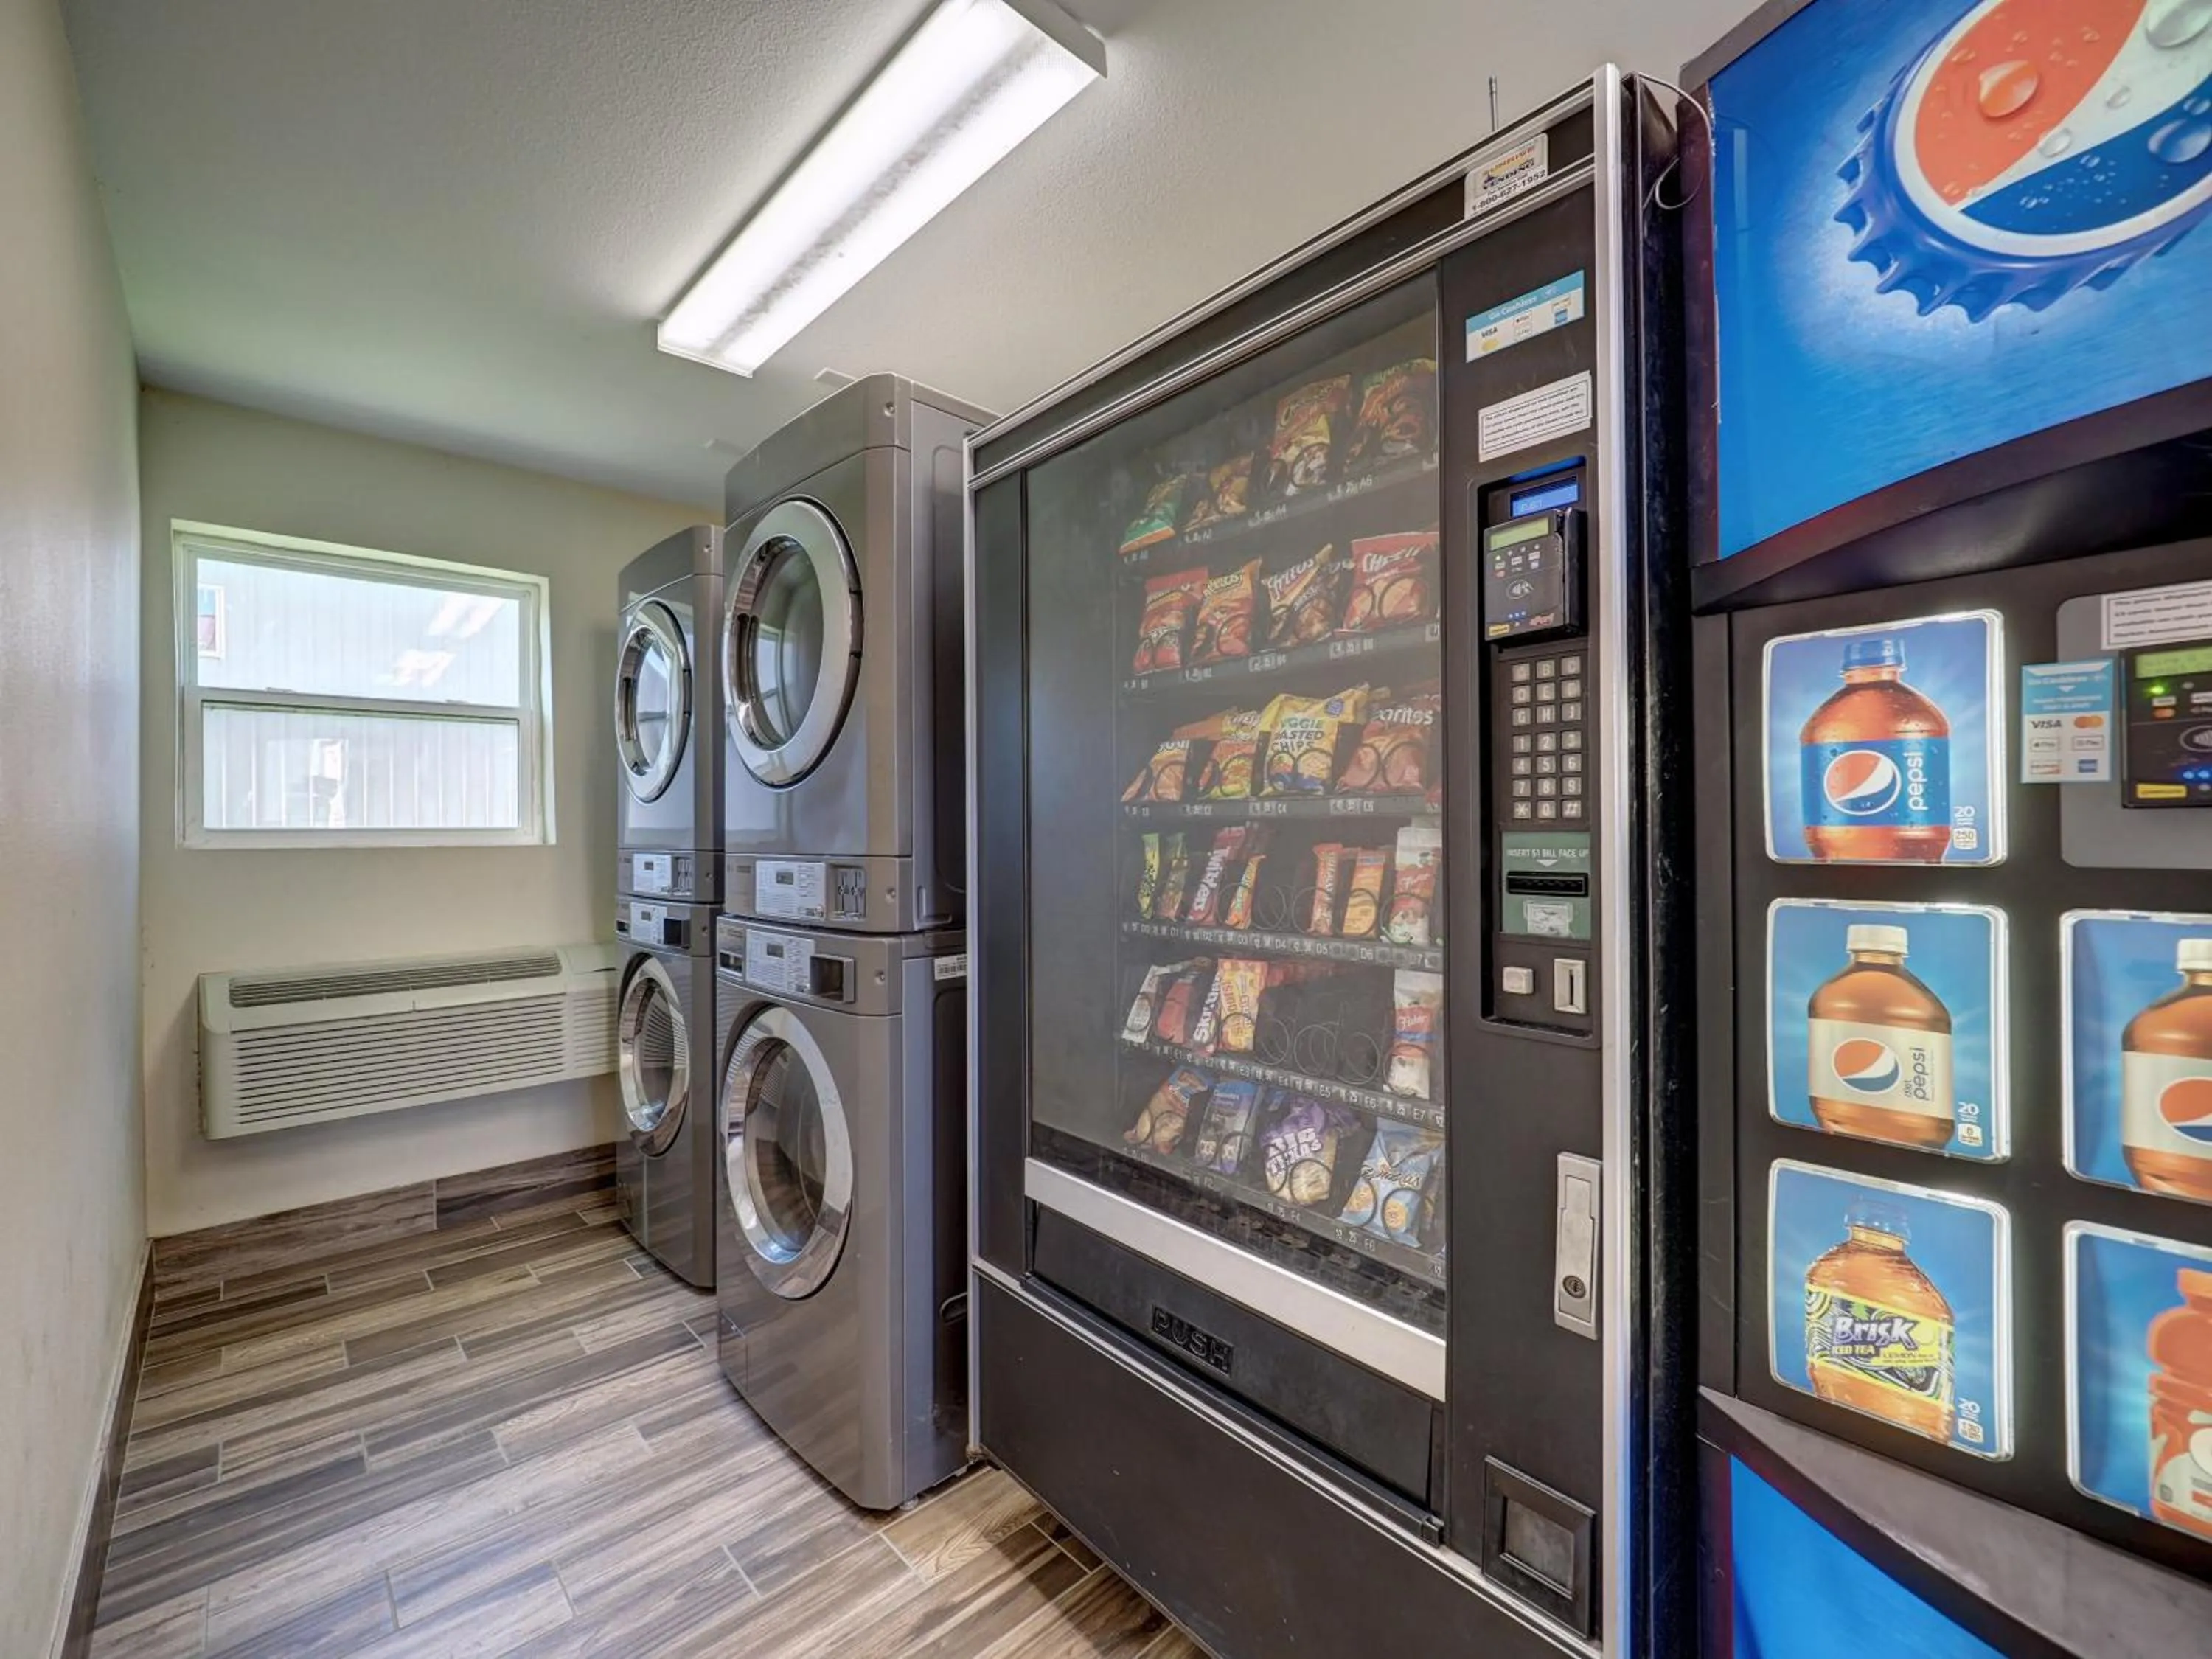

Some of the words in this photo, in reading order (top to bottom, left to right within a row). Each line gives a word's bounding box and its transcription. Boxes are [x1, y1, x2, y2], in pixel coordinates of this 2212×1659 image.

[2031, 719, 2062, 730] VISA
[1274, 729, 1325, 740] ASTED
[1519, 737, 1526, 749] 1
[1543, 735, 1551, 748] 2
[1517, 759, 1526, 771] 4
[1543, 757, 1551, 771] 5
[1568, 756, 1576, 769] 6
[1519, 781, 1526, 794] 7
[1567, 779, 1576, 793] 9
[1902, 751, 1929, 811] pepsi
[1952, 805, 1976, 818] 20
[1316, 943, 1329, 956] D5
[1908, 1045, 1930, 1101] pepsi
[1958, 1101, 1980, 1116] 20
[1154, 1310, 1228, 1371] PUSH
[1832, 1344, 1853, 1354] ICED
[1854, 1345, 1875, 1355] TEA
[1958, 1397, 1980, 1415] 20
